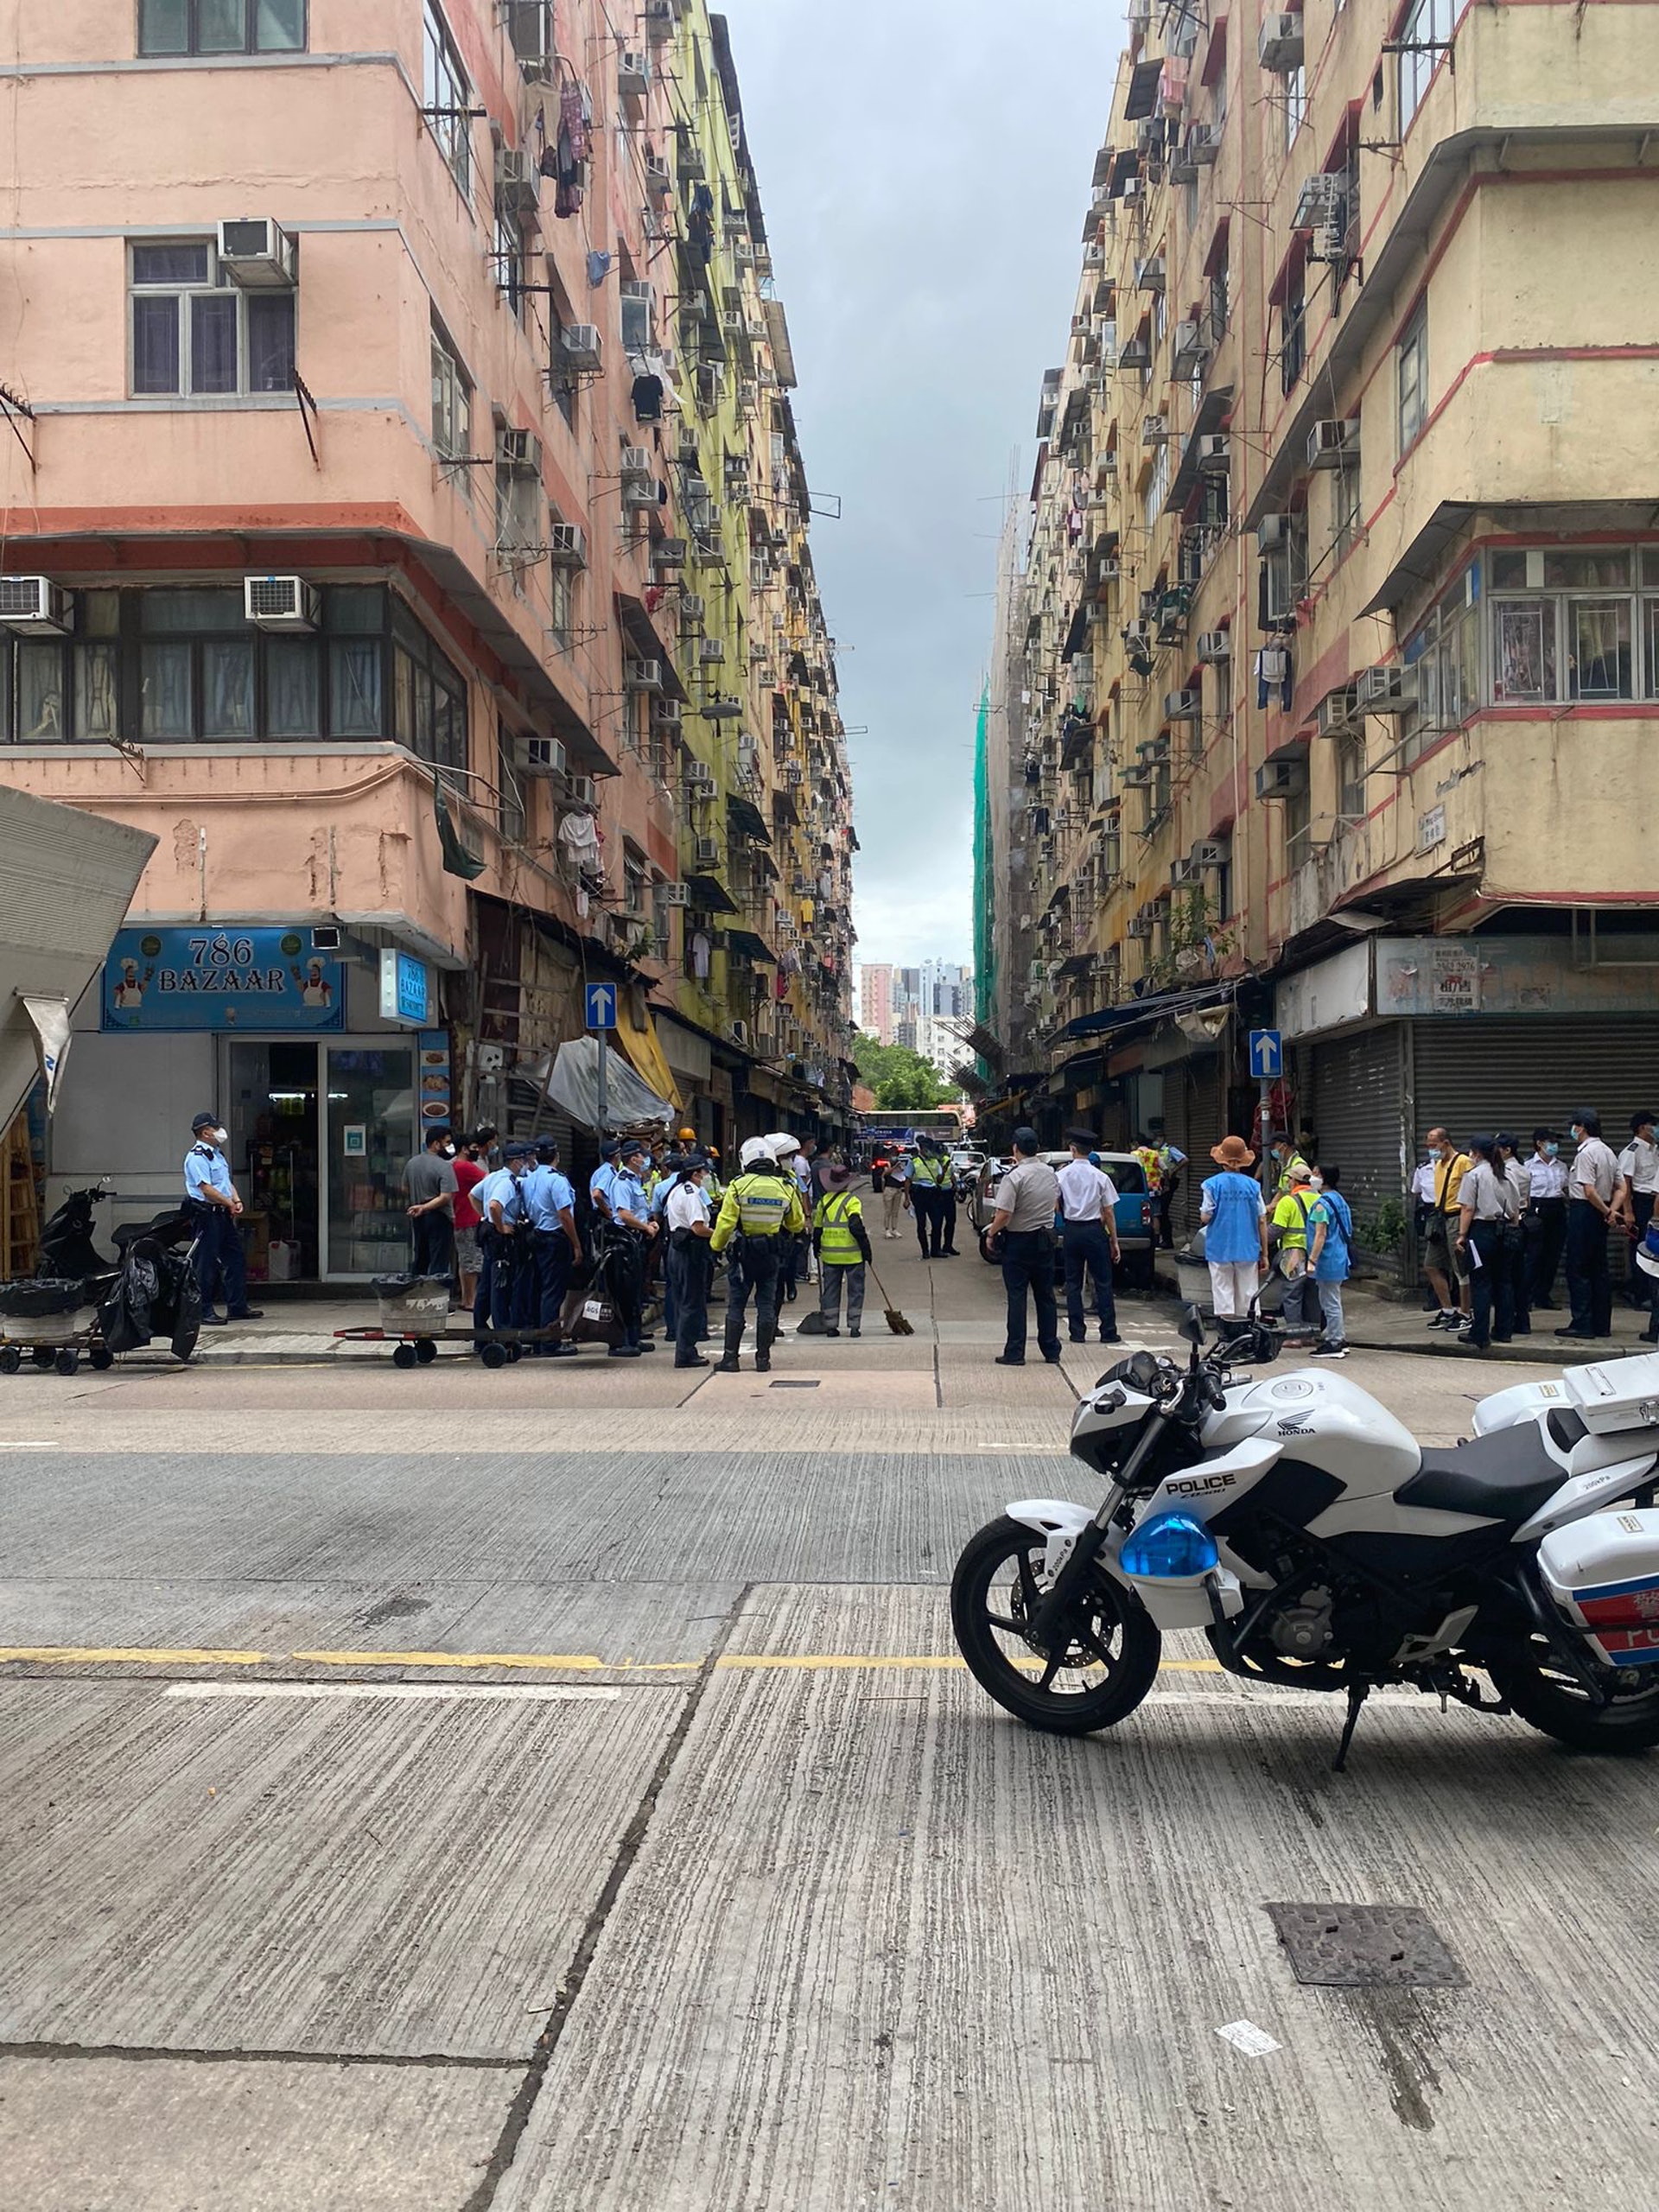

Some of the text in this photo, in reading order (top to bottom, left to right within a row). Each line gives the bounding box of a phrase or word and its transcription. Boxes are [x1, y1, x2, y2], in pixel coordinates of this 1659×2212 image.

[189, 933, 253, 967] 786
[159, 969, 285, 993] BAZAAR
[754, 1198, 777, 1206] POLICE
[1277, 1427, 1316, 1437] HONDA
[1166, 1473, 1236, 1496] POLICE
